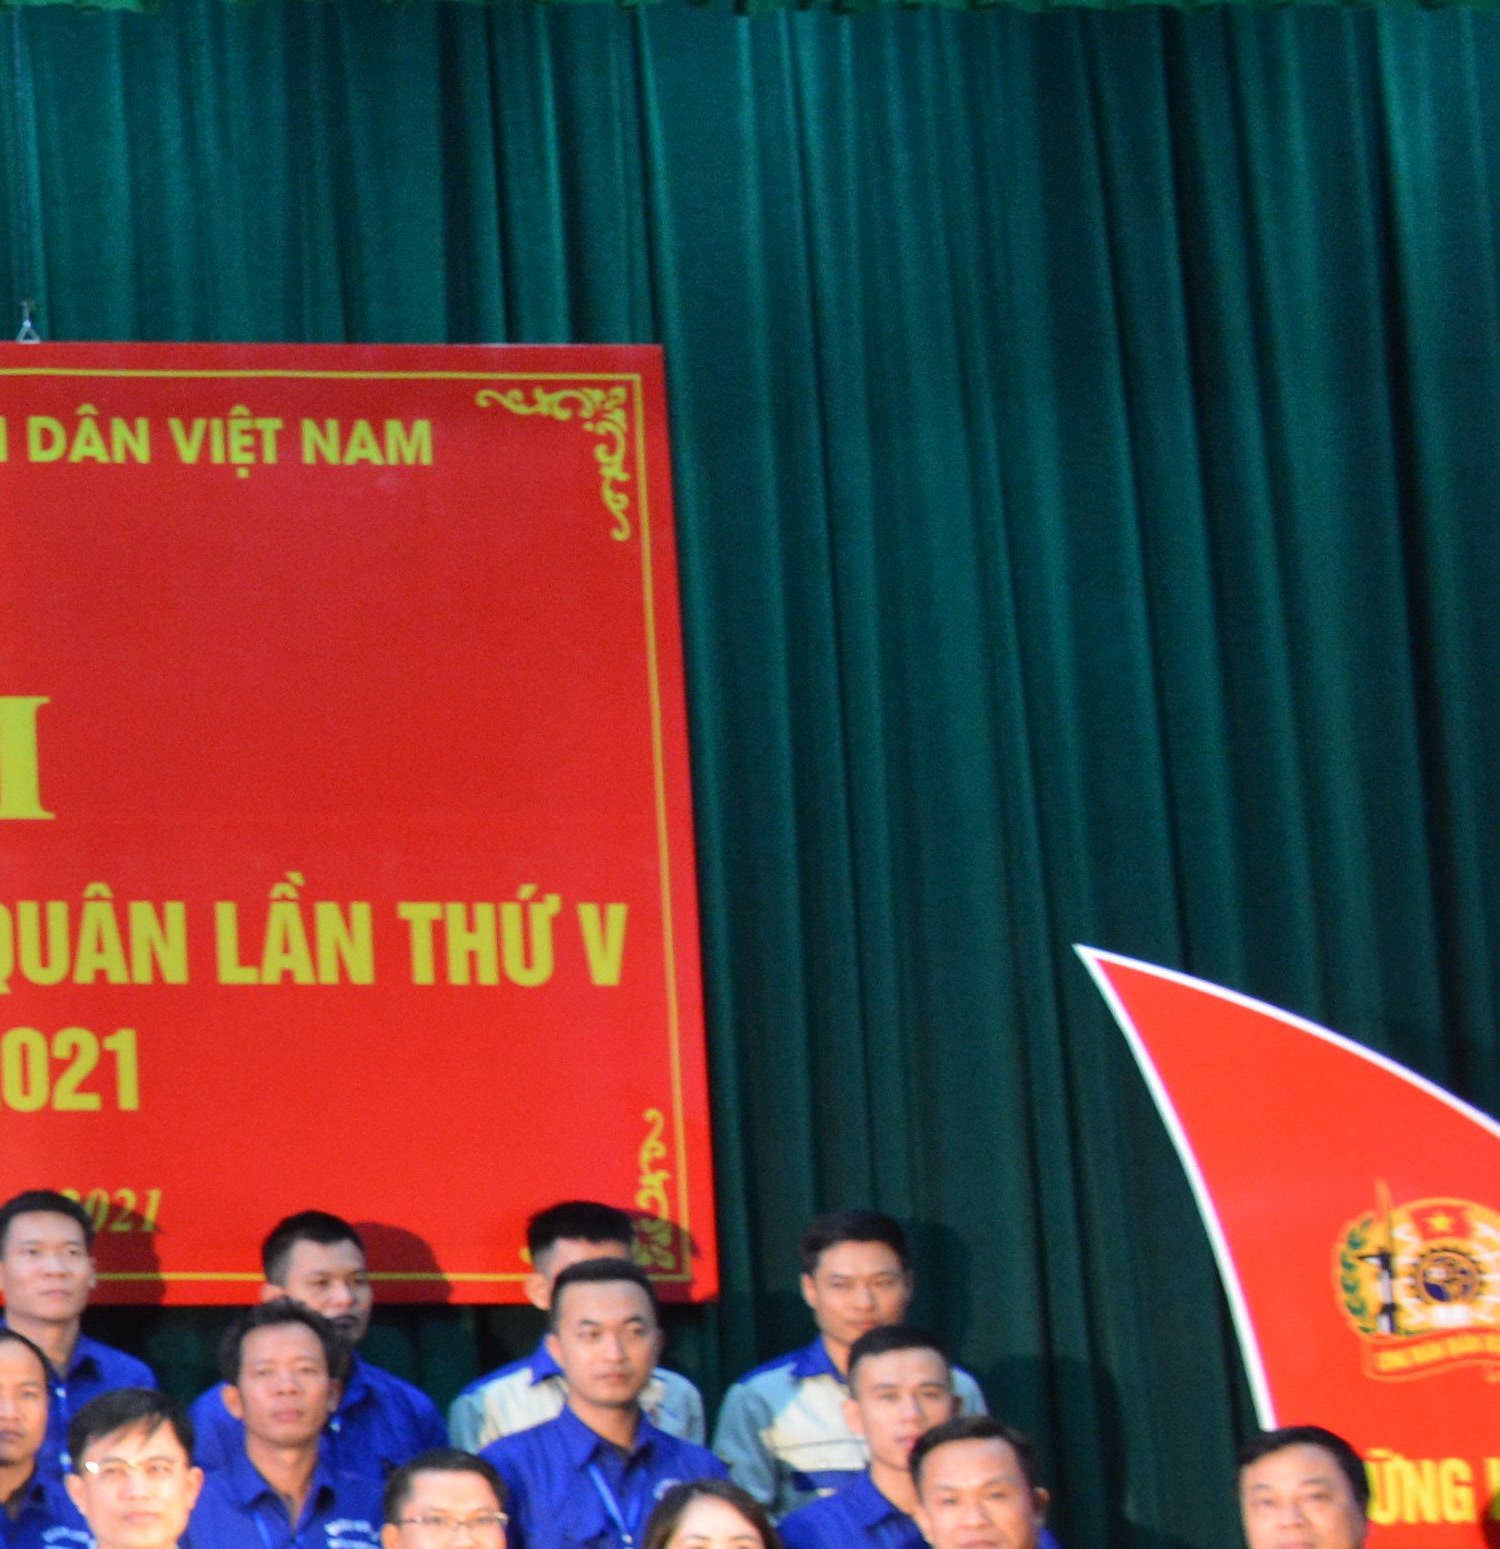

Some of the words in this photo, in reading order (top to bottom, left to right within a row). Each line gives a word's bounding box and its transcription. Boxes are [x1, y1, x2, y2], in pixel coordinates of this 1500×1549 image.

[28, 403, 151, 464] DÂN
[169, 404, 283, 478] VIỆT
[302, 418, 433, 466] NAM
[216, 870, 373, 984] LẦN
[399, 884, 560, 986] THỨ
[579, 903, 627, 985] V
